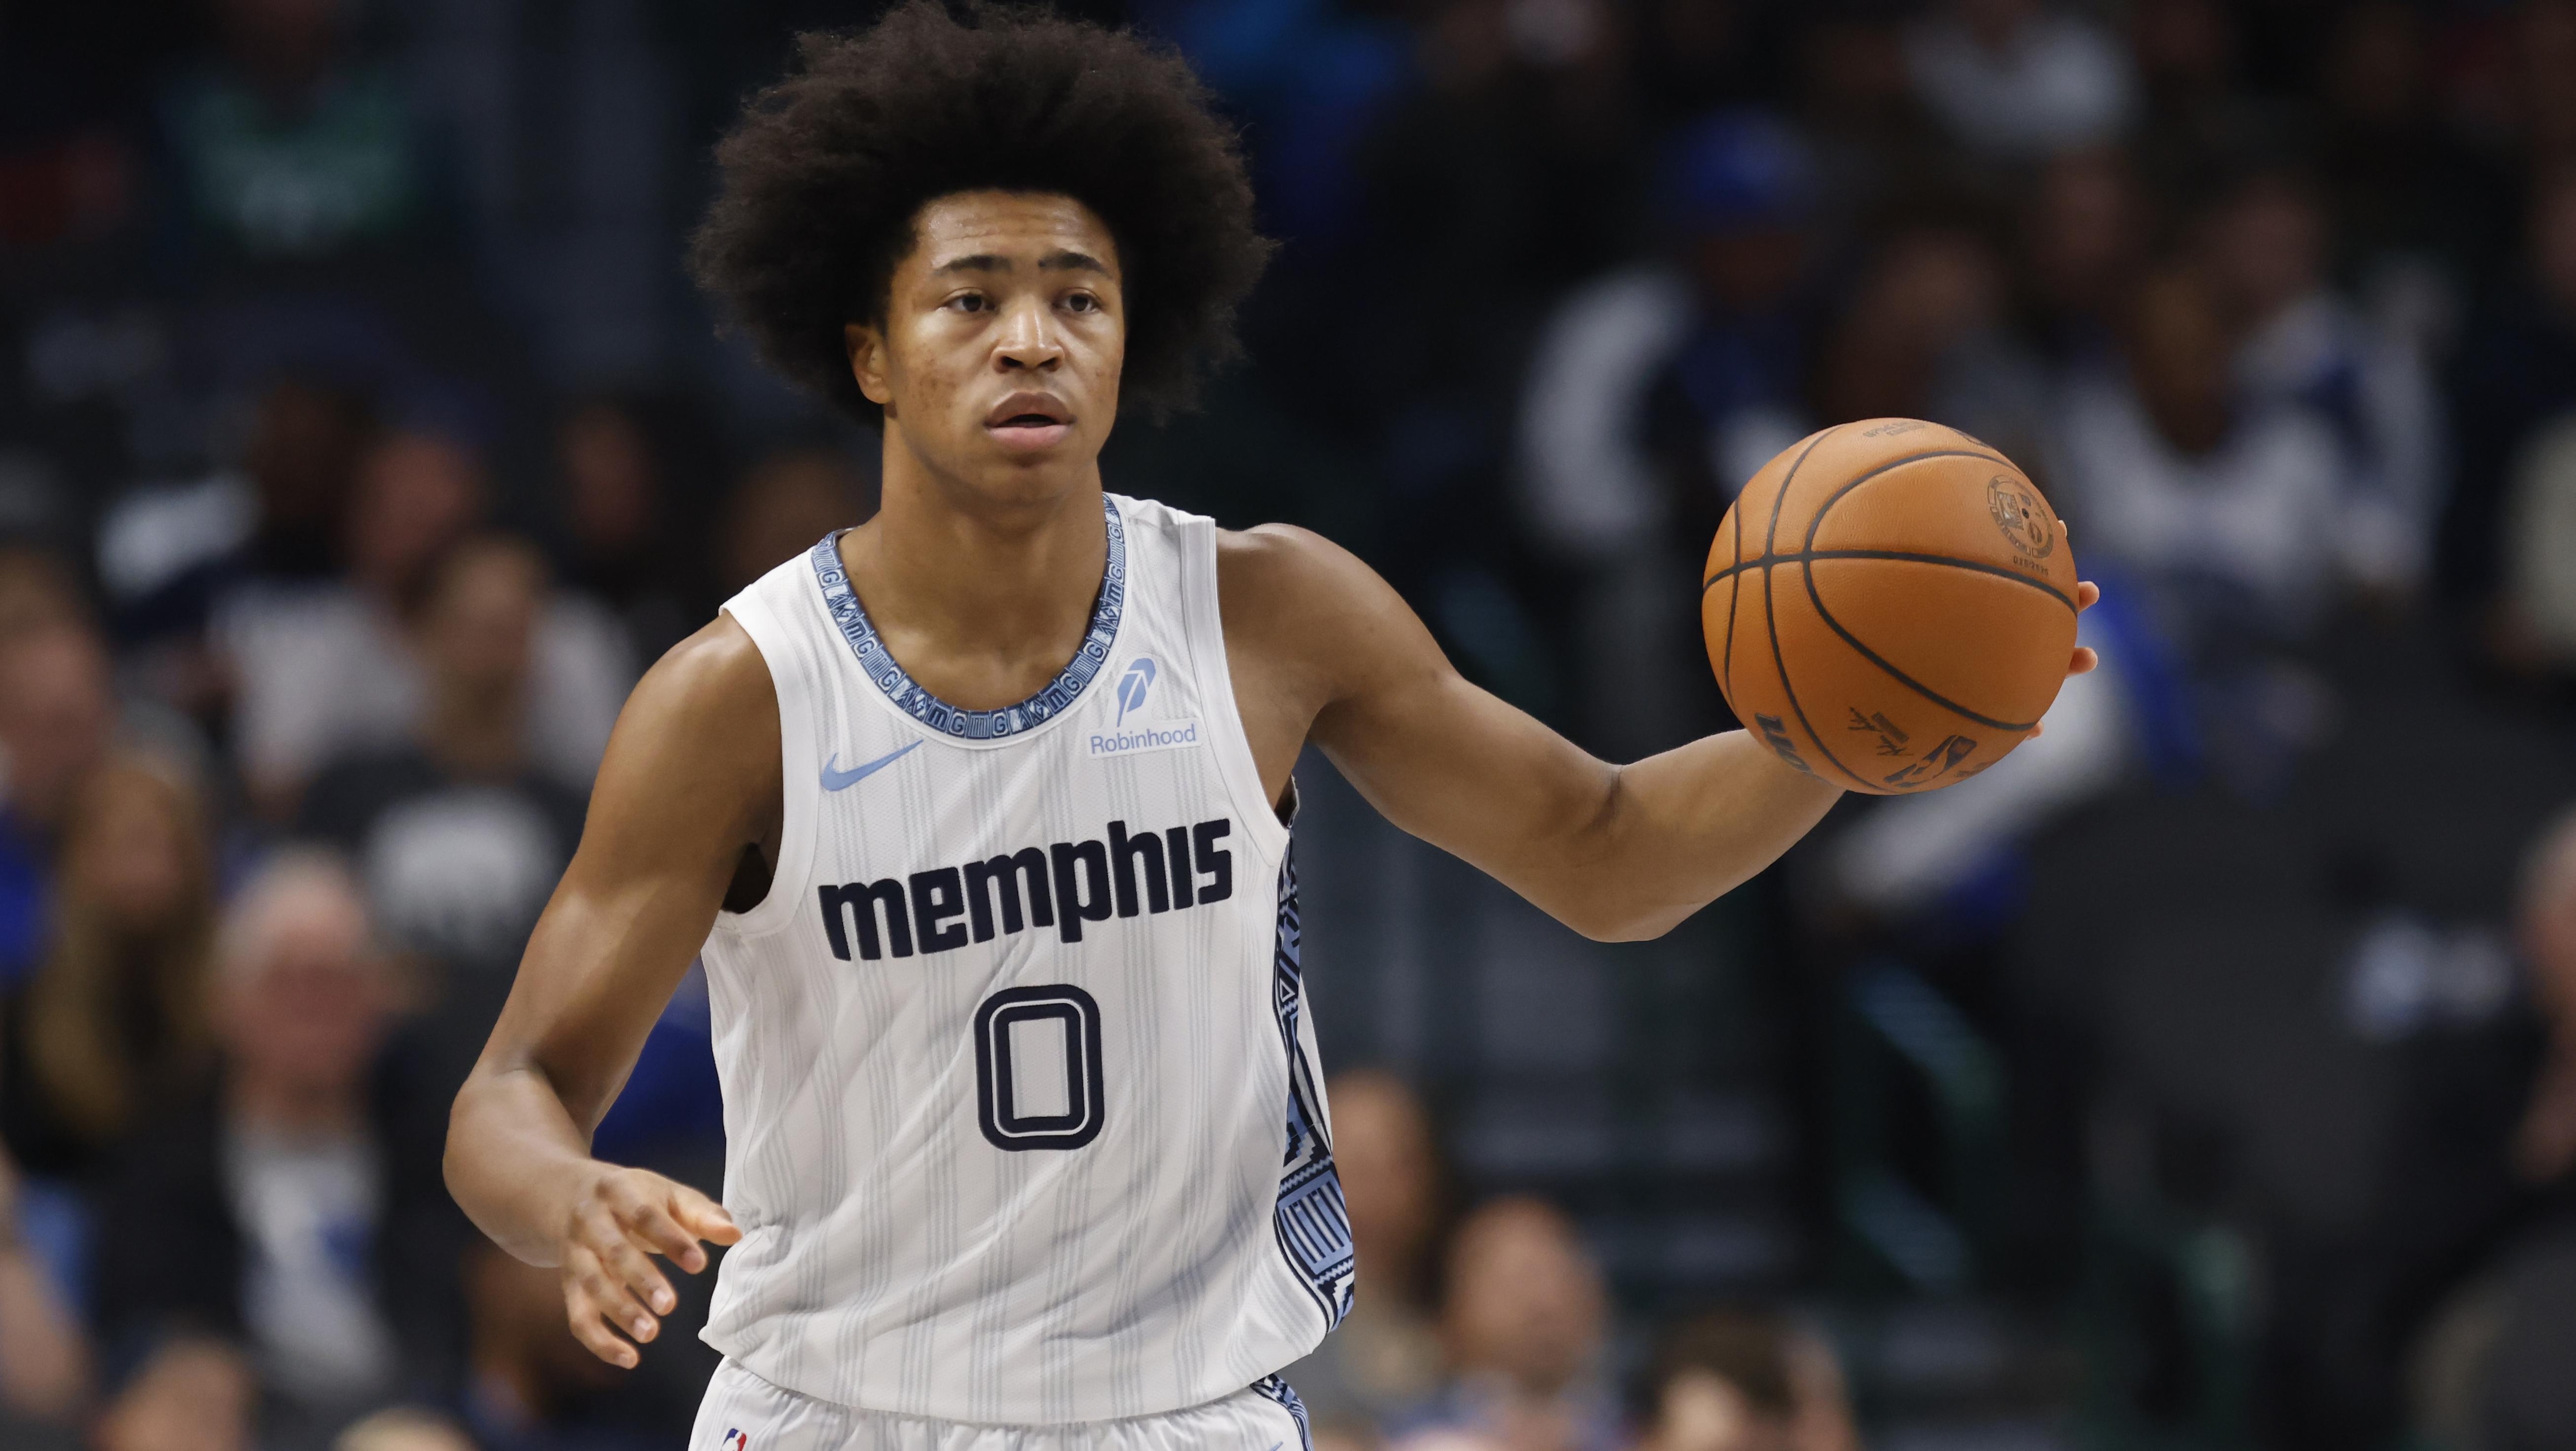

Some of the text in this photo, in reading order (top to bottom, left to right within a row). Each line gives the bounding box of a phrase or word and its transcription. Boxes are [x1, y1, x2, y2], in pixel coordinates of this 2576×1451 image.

[1090, 723, 1196, 754] Robinhood
[818, 819, 1232, 961] memphis
[974, 984, 1105, 1151] 0
